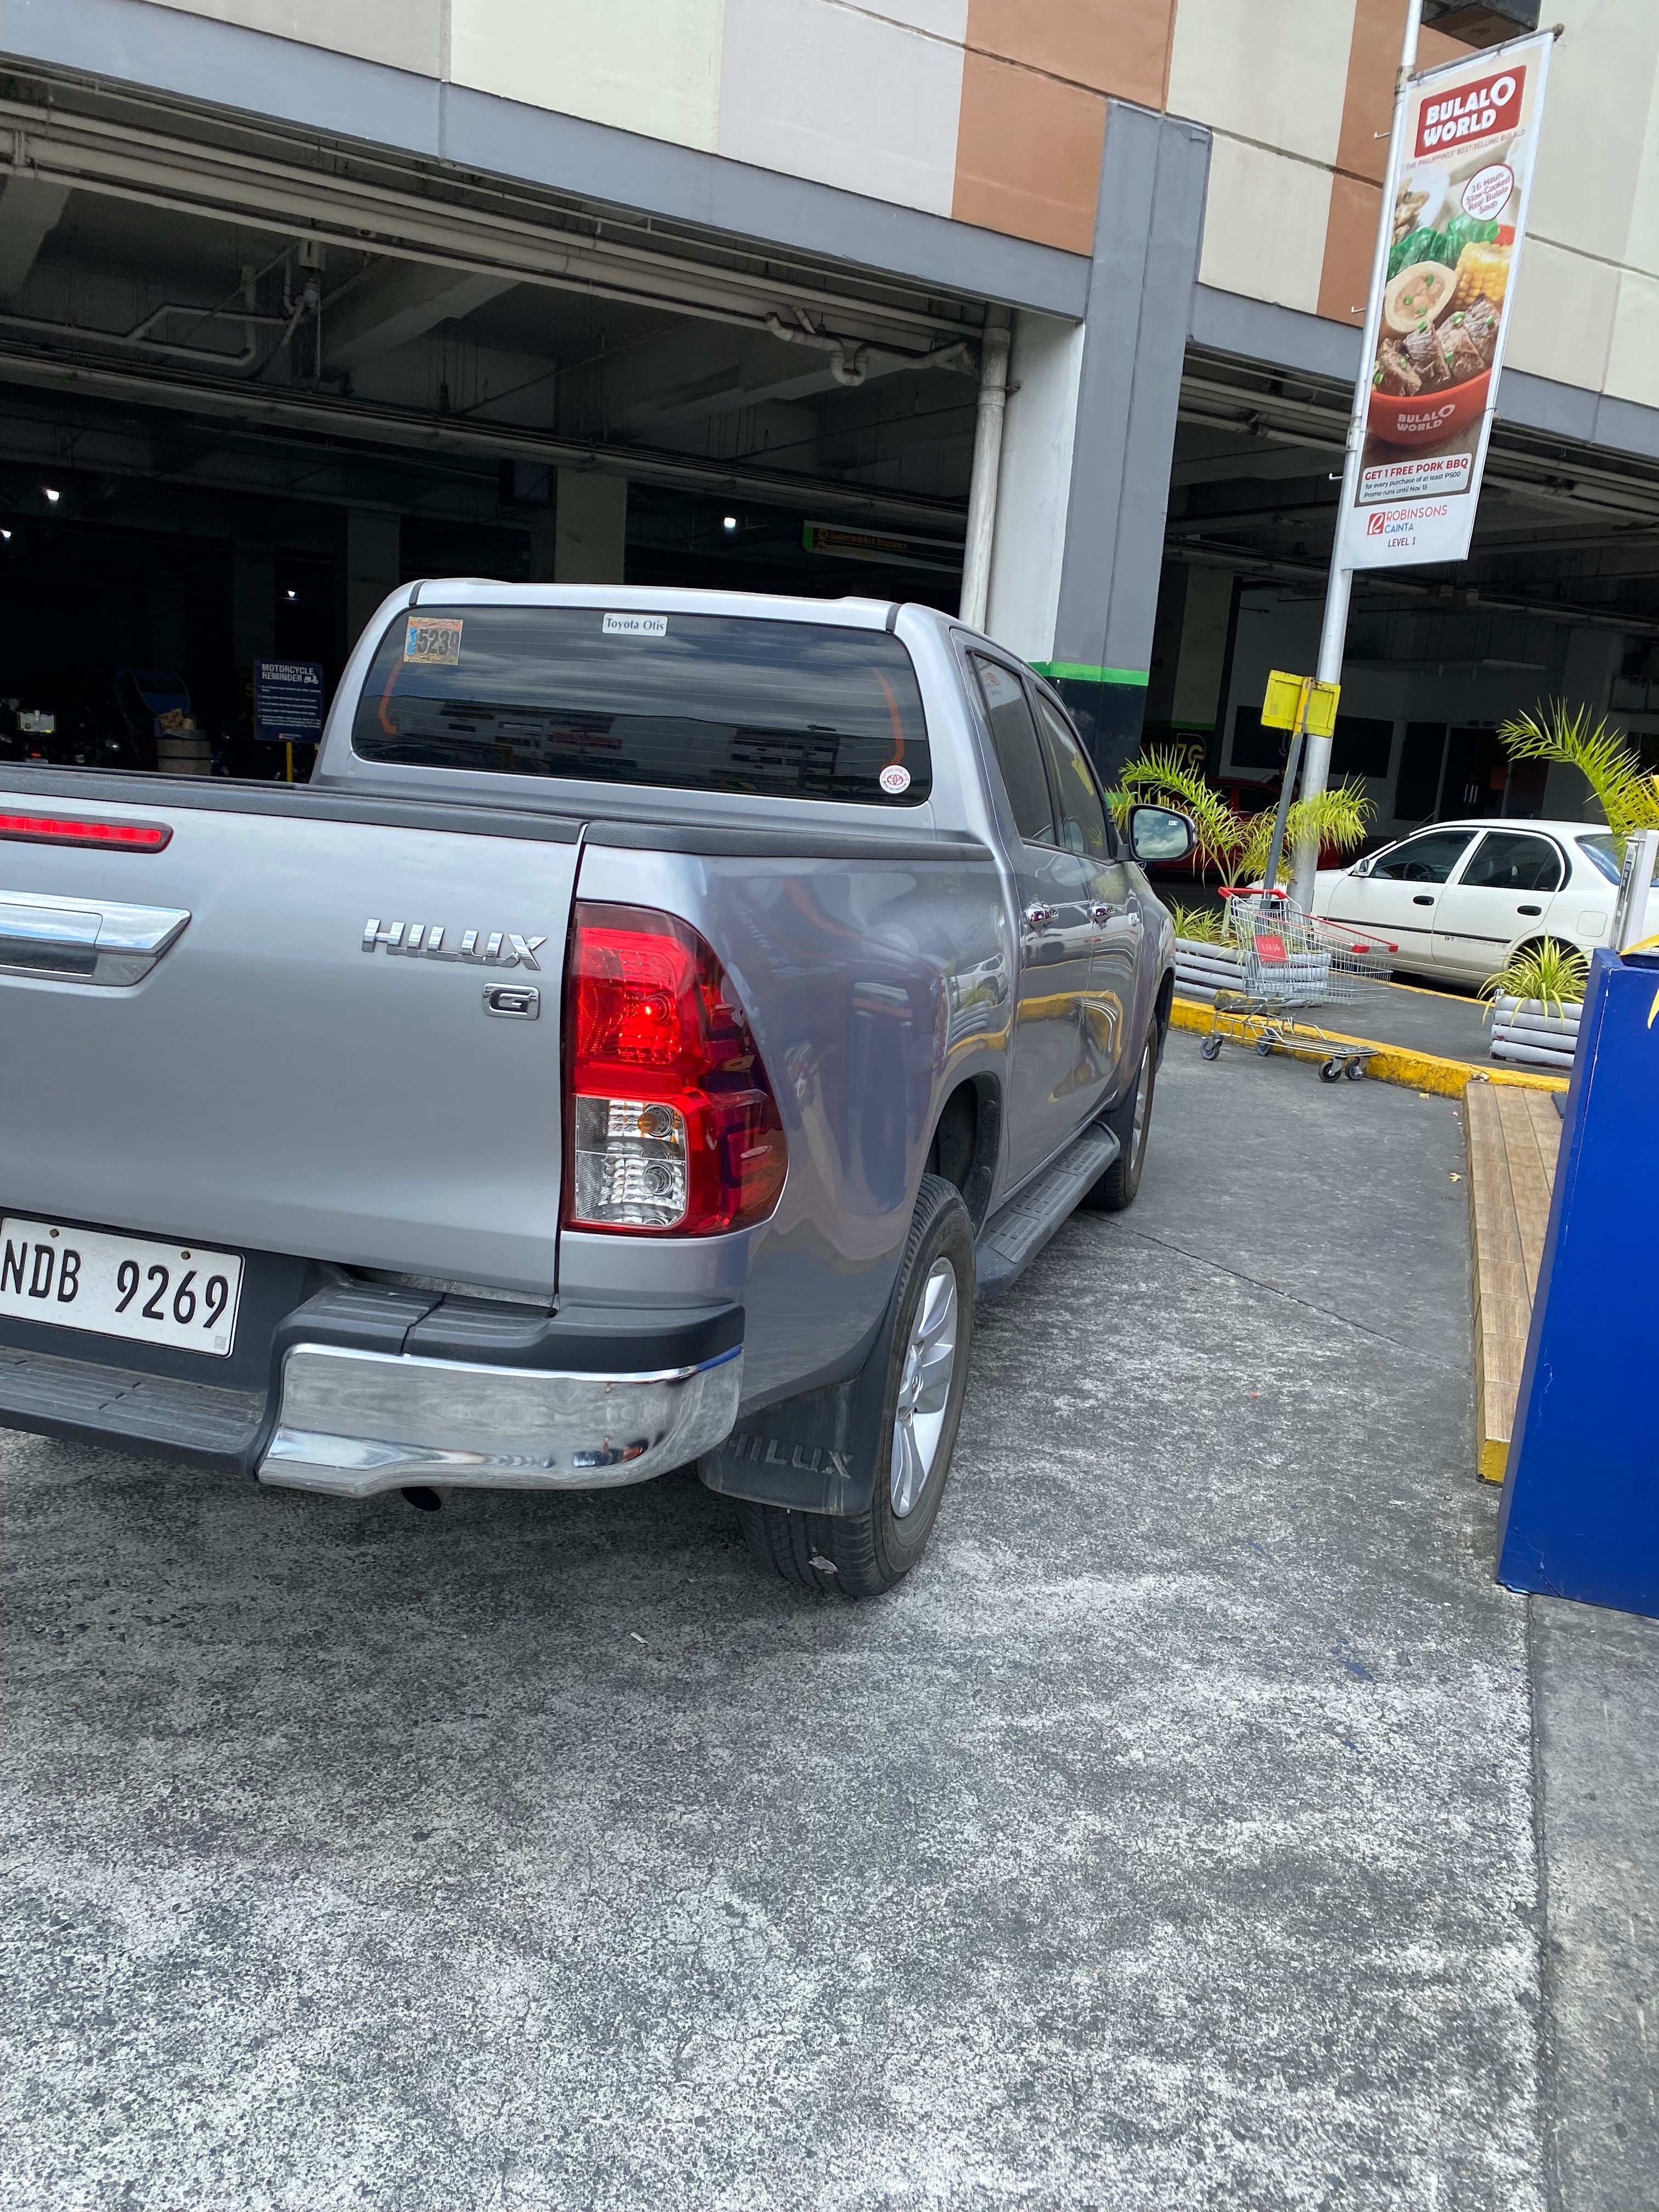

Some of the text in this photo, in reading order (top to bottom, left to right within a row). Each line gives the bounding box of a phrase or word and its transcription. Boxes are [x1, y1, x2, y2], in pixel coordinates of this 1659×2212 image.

[1426, 76, 1516, 126] BULALO
[1424, 109, 1497, 147] WORLD
[1407, 162, 1417, 170] THE
[1472, 172, 1504, 193] 16 Hours
[1469, 187, 1509, 211] Real Bulalo
[1480, 200, 1498, 213] Soup
[1398, 404, 1455, 422] BULALO
[1397, 419, 1443, 432] WORLD
[1365, 458, 1468, 481] GET 1 FREE PORK BBQ
[1390, 478, 1415, 487] purchase
[1386, 505, 1448, 522] ROBINSONS
[1385, 523, 1414, 533] CAINTA
[1388, 537, 1416, 547] LEVEL 1
[607, 618, 664, 631] Toyota Otis
[417, 629, 460, 656] 5239
[262, 664, 314, 675] MOTORCYCLE
[262, 672, 302, 682] REMINDER
[362, 918, 547, 970] HILUX
[483, 983, 540, 1021] G
[1, 1239, 230, 1328] NDB 9269
[729, 1432, 853, 1479] HILUX
